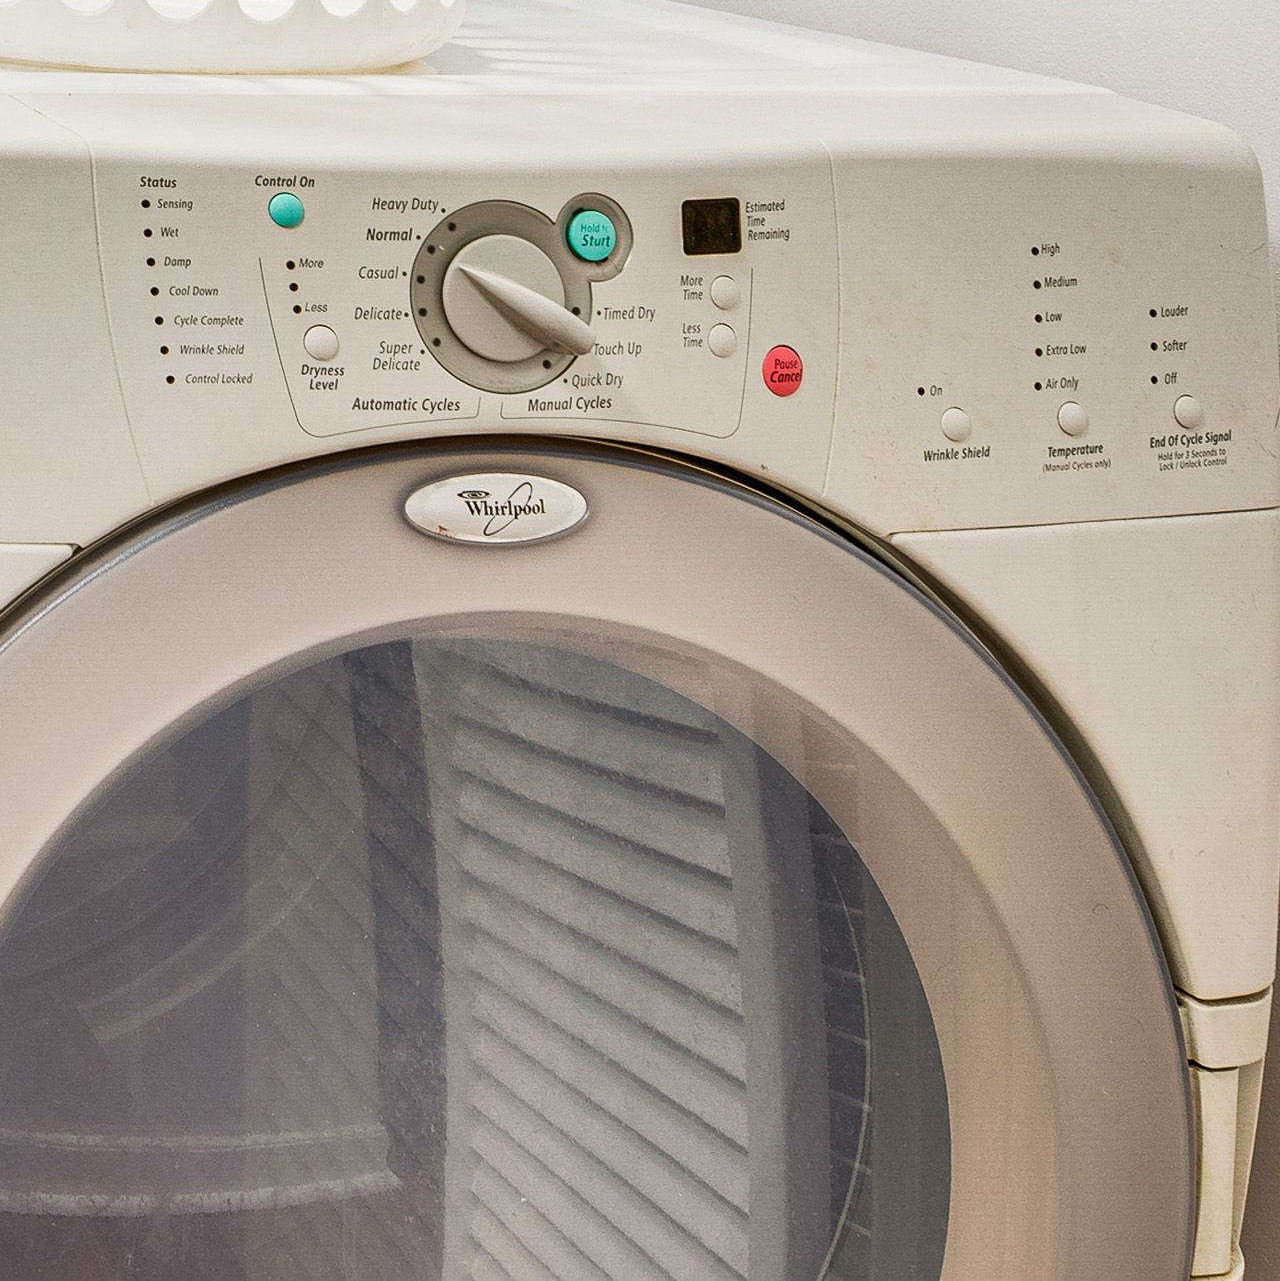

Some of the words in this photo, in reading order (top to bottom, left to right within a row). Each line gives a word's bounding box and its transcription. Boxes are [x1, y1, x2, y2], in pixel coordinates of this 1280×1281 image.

[140, 176, 177, 188] Status
[255, 175, 296, 187] Control
[300, 176, 315, 188] On
[157, 199, 193, 211] Sensing
[372, 198, 408, 214] Heavy
[411, 198, 439, 214] Duty
[746, 199, 785, 213] Estimated
[746, 216, 765, 226] Time
[161, 227, 179, 237] Wet
[366, 228, 413, 241] Normal
[748, 228, 790, 241] Remaining
[1041, 243, 1060, 256] High
[164, 257, 191, 268] Damp
[299, 258, 324, 268] More
[359, 266, 398, 278] Casual
[681, 275, 703, 286] More
[1044, 277, 1078, 288] Medium
[169, 286, 190, 296] Cool
[193, 286, 219, 296] Down
[683, 289, 703, 300] Time
[305, 302, 328, 312] Less
[1161, 305, 1188, 318] Louder
[354, 307, 402, 320] Delicate
[604, 307, 635, 320] Timed
[638, 307, 656, 321] Dry
[1045, 312, 1062, 322] Low
[174, 315, 198, 327] Cycle
[201, 315, 244, 327] Complete
[683, 323, 701, 334] Less
[379, 341, 413, 356] Super
[683, 337, 703, 348] Time
[1163, 340, 1187, 352] Softer
[180, 344, 214, 355] Wrinkle
[217, 344, 244, 355] Shield
[594, 342, 624, 356] Touch
[628, 342, 642, 357] Up
[1046, 345, 1068, 356] Extra
[1070, 344, 1087, 354] Low
[372, 357, 421, 370] Delicate
[775, 359, 798, 369] Pause
[301, 364, 345, 378] Dryness
[185, 374, 219, 384] Control
[221, 374, 253, 384] Locked
[309, 379, 338, 390] Level
[572, 374, 602, 389] Quick
[605, 373, 624, 388] Dry
[1046, 378, 1058, 390] Air
[1060, 376, 1079, 390] Only
[1164, 372, 1178, 385] Off
[930, 386, 943, 396] On
[352, 398, 418, 411] Automatic
[422, 398, 461, 414] Cycles
[528, 397, 572, 411] Manual
[576, 396, 612, 412] Cycles
[1150, 436, 1166, 448] End
[1168, 435, 1179, 446] Of
[1181, 433, 1203, 447] Cycle
[1205, 430, 1232, 445] Signal
[923, 448, 960, 462] Wrinkle
[962, 446, 990, 459] Shield
[1048, 444, 1104, 459] Temperature
[465, 498, 546, 519] Whirlpool
